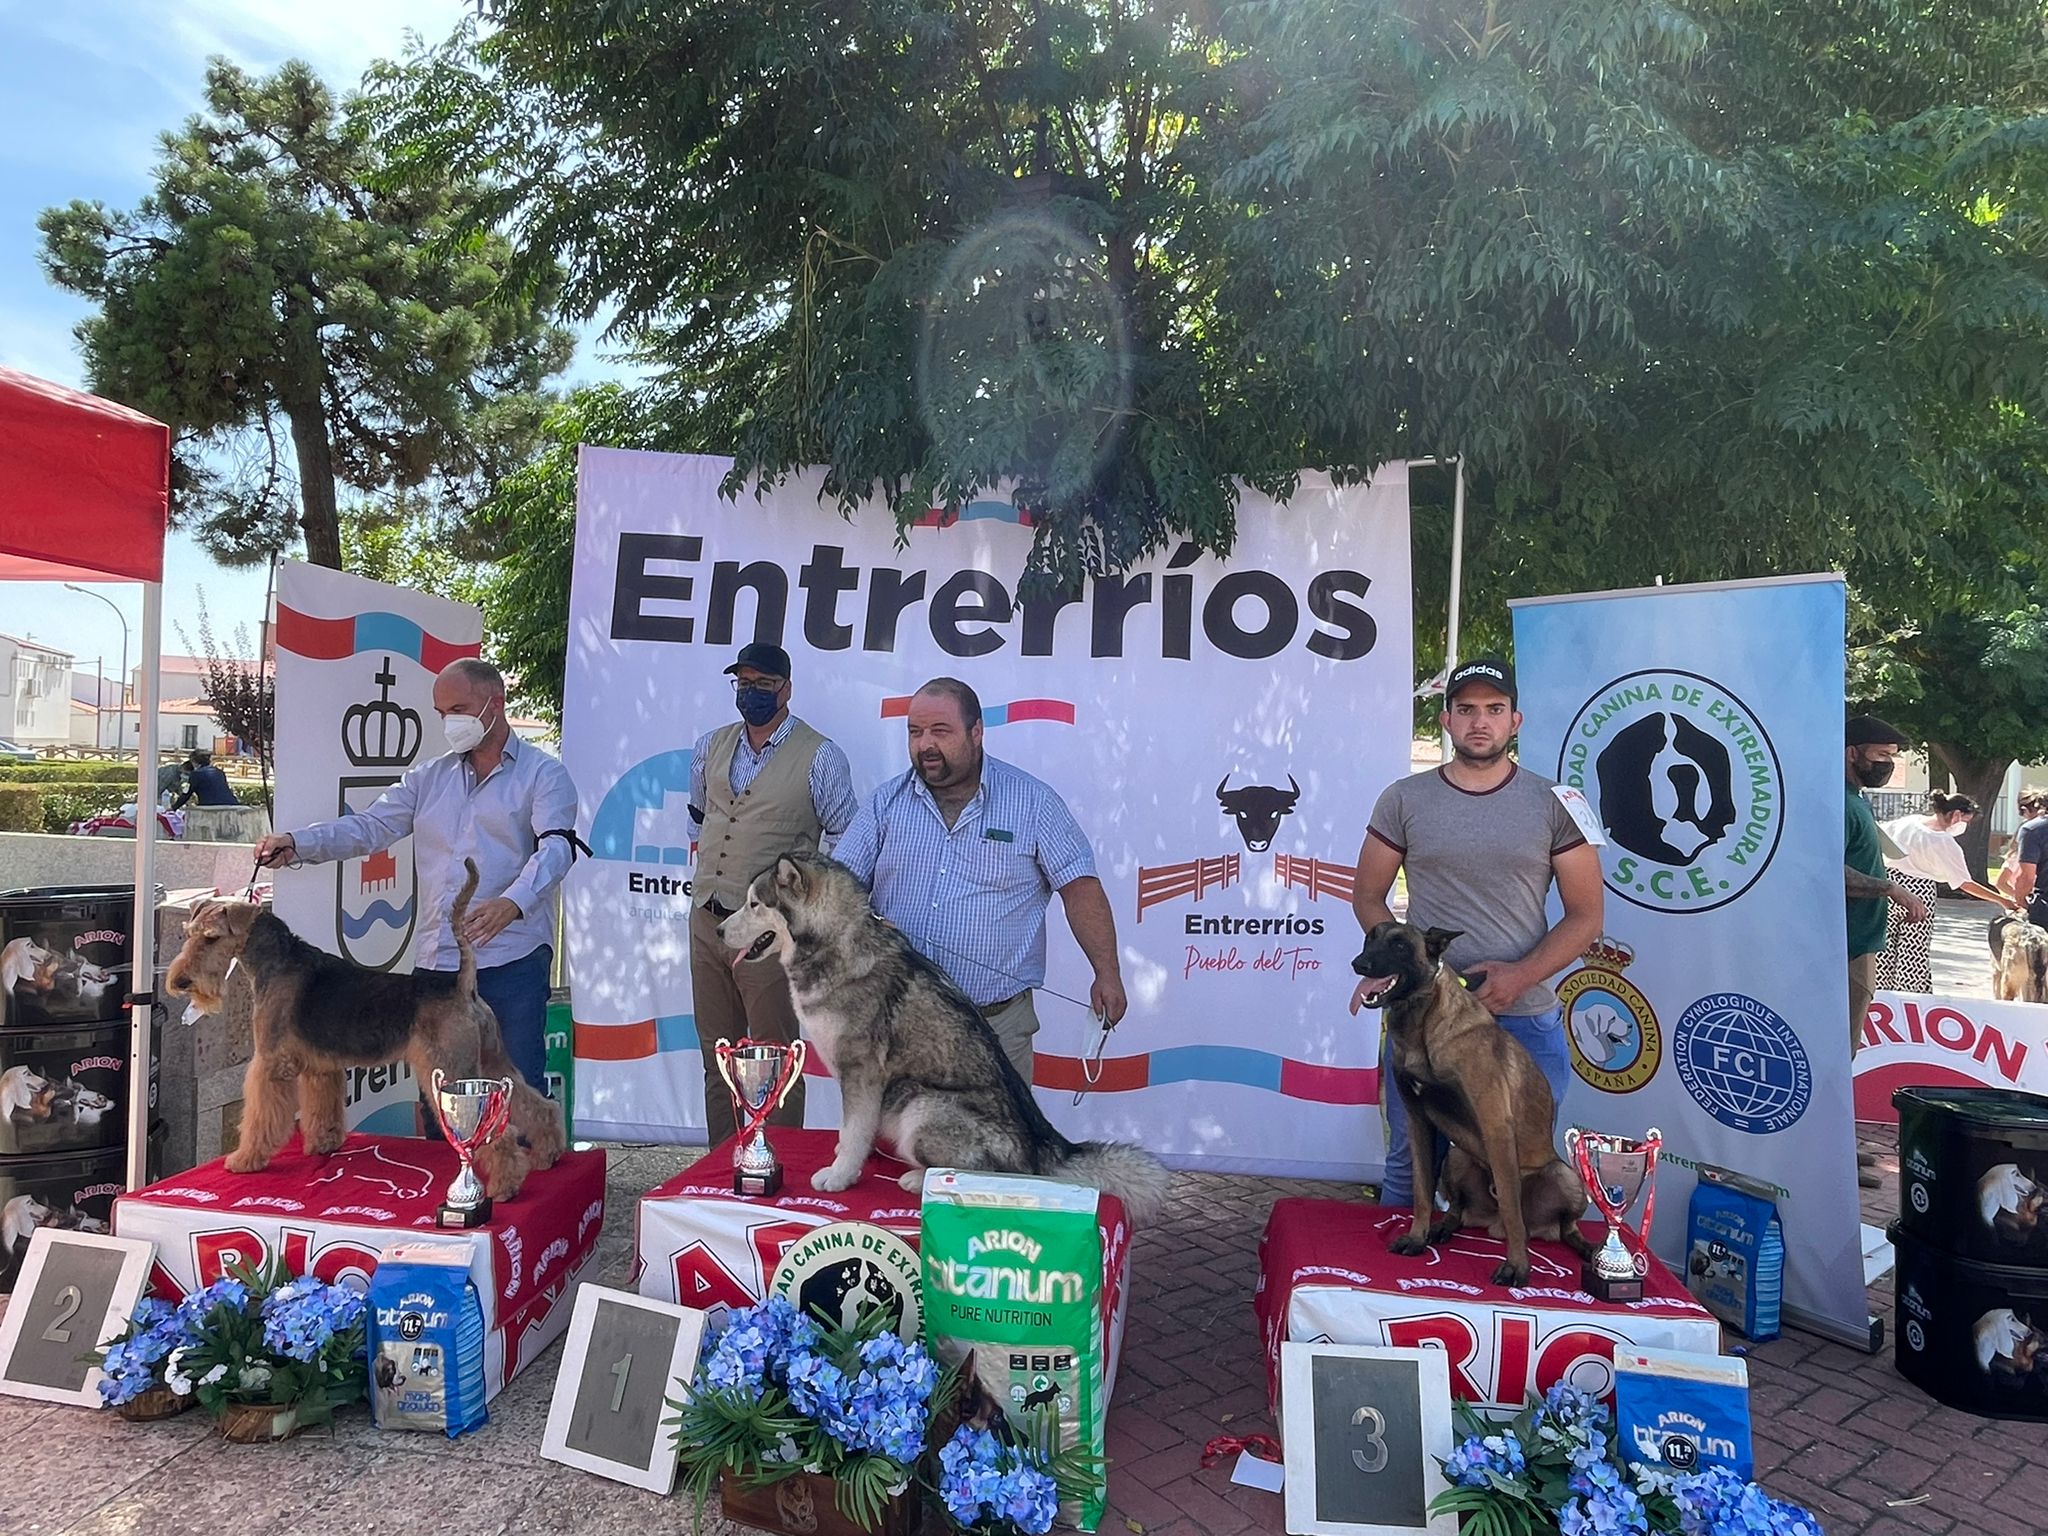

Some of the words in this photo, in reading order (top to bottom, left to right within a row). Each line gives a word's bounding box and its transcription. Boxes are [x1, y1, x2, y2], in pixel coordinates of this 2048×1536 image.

[610, 532, 1377, 661] Entrerríos
[1455, 665, 1503, 681] adidas
[1581, 683, 1662, 738] CANINA
[1671, 684, 1703, 707] DE
[1706, 699, 1772, 867] EXTREMADURA
[1611, 857, 1730, 899] S.C.E.
[74, 930, 126, 949] ARION
[1185, 913, 1324, 935] Entrerríos
[1184, 944, 1247, 980] Pueblo
[1253, 947, 1285, 972] del
[1283, 948, 1322, 981] Toro
[1563, 972, 1628, 997] SOCIEDAD
[1628, 994, 1657, 1053] CANINA
[1682, 995, 1776, 1029] CYNOLOGIQUE
[1859, 1002, 2029, 1083] RION
[70, 1056, 124, 1078] ARION
[1576, 1059, 1637, 1089] ESPAÑA
[1675, 1030, 1720, 1117] FEDERATION
[1713, 1045, 1768, 1082] FCI
[1763, 1024, 1810, 1132] INTERNATIONALE
[74, 1183, 126, 1206] ARION
[230, 1197, 305, 1212] ARION
[776, 1197, 850, 1213] ARION
[319, 1205, 396, 1221] ARION
[499, 1225, 524, 1300] ARION
[793, 1232, 855, 1267] CANINA
[862, 1234, 886, 1256] DE
[967, 1229, 1043, 1264] ARION
[1292, 1265, 1371, 1284] ARION
[1397, 1278, 1483, 1296] ARION
[399, 1293, 435, 1309] ARION
[1508, 1286, 1595, 1305] ARION
[41, 1285, 83, 1343] 2
[951, 1304, 981, 1321] PURE
[985, 1307, 1052, 1327] NUTRITION
[610, 1353, 633, 1412] 1
[1658, 1411, 1706, 1433] ARION
[1351, 1405, 1389, 1474] 3
